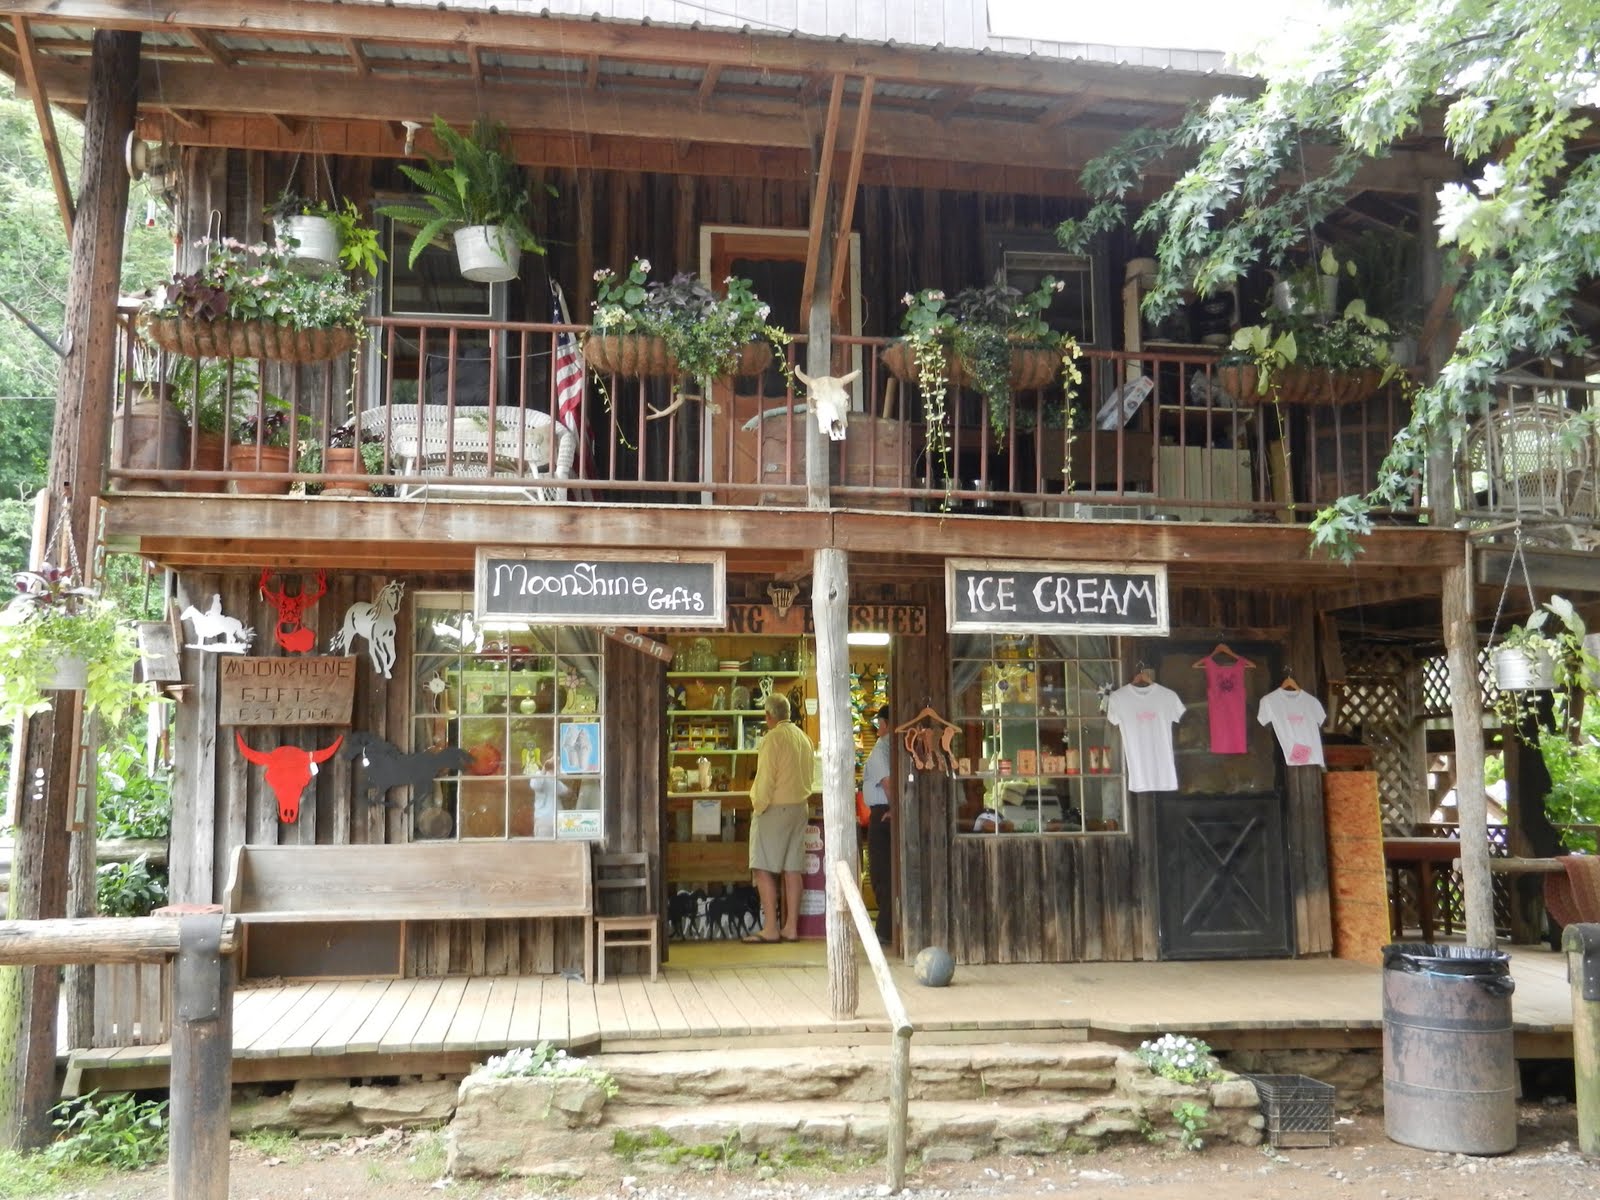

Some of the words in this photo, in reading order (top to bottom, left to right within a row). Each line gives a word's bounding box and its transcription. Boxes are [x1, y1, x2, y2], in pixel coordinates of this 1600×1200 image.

[648, 587, 704, 611] Gifts
[967, 576, 1016, 613] ICE
[1033, 576, 1157, 618] CREAM
[624, 633, 643, 647] on
[225, 660, 351, 678] MOONSHINE
[241, 687, 321, 703] GIFTS
